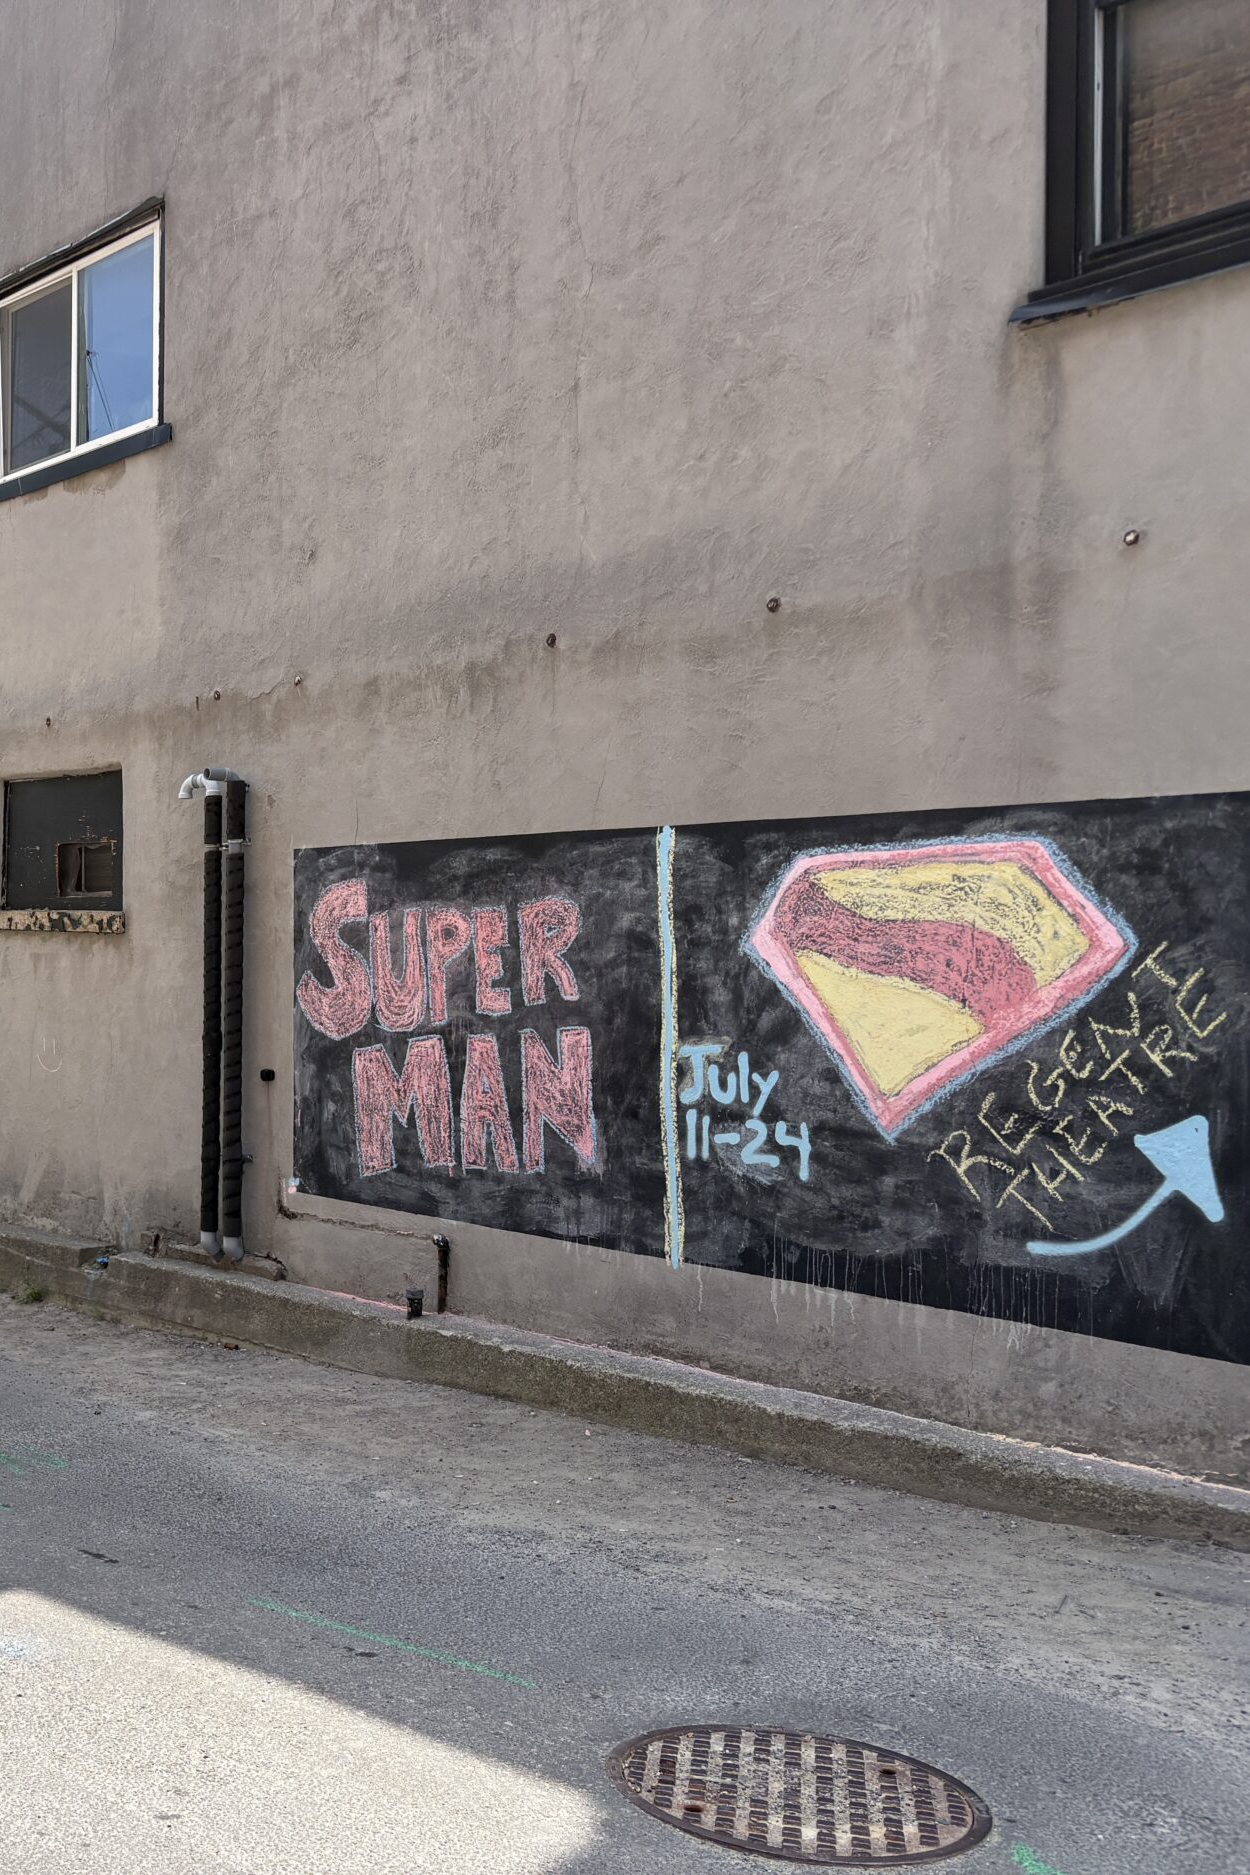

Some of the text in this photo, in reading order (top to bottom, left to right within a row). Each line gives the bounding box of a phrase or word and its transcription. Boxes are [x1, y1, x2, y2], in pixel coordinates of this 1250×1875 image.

[296, 877, 584, 1040] SUPER
[352, 1026, 597, 1177] MAN
[679, 1045, 779, 1117] July
[685, 1115, 812, 1182] 11-24
[926, 941, 1179, 1201] REGENT
[995, 967, 1227, 1232] THEATRE
